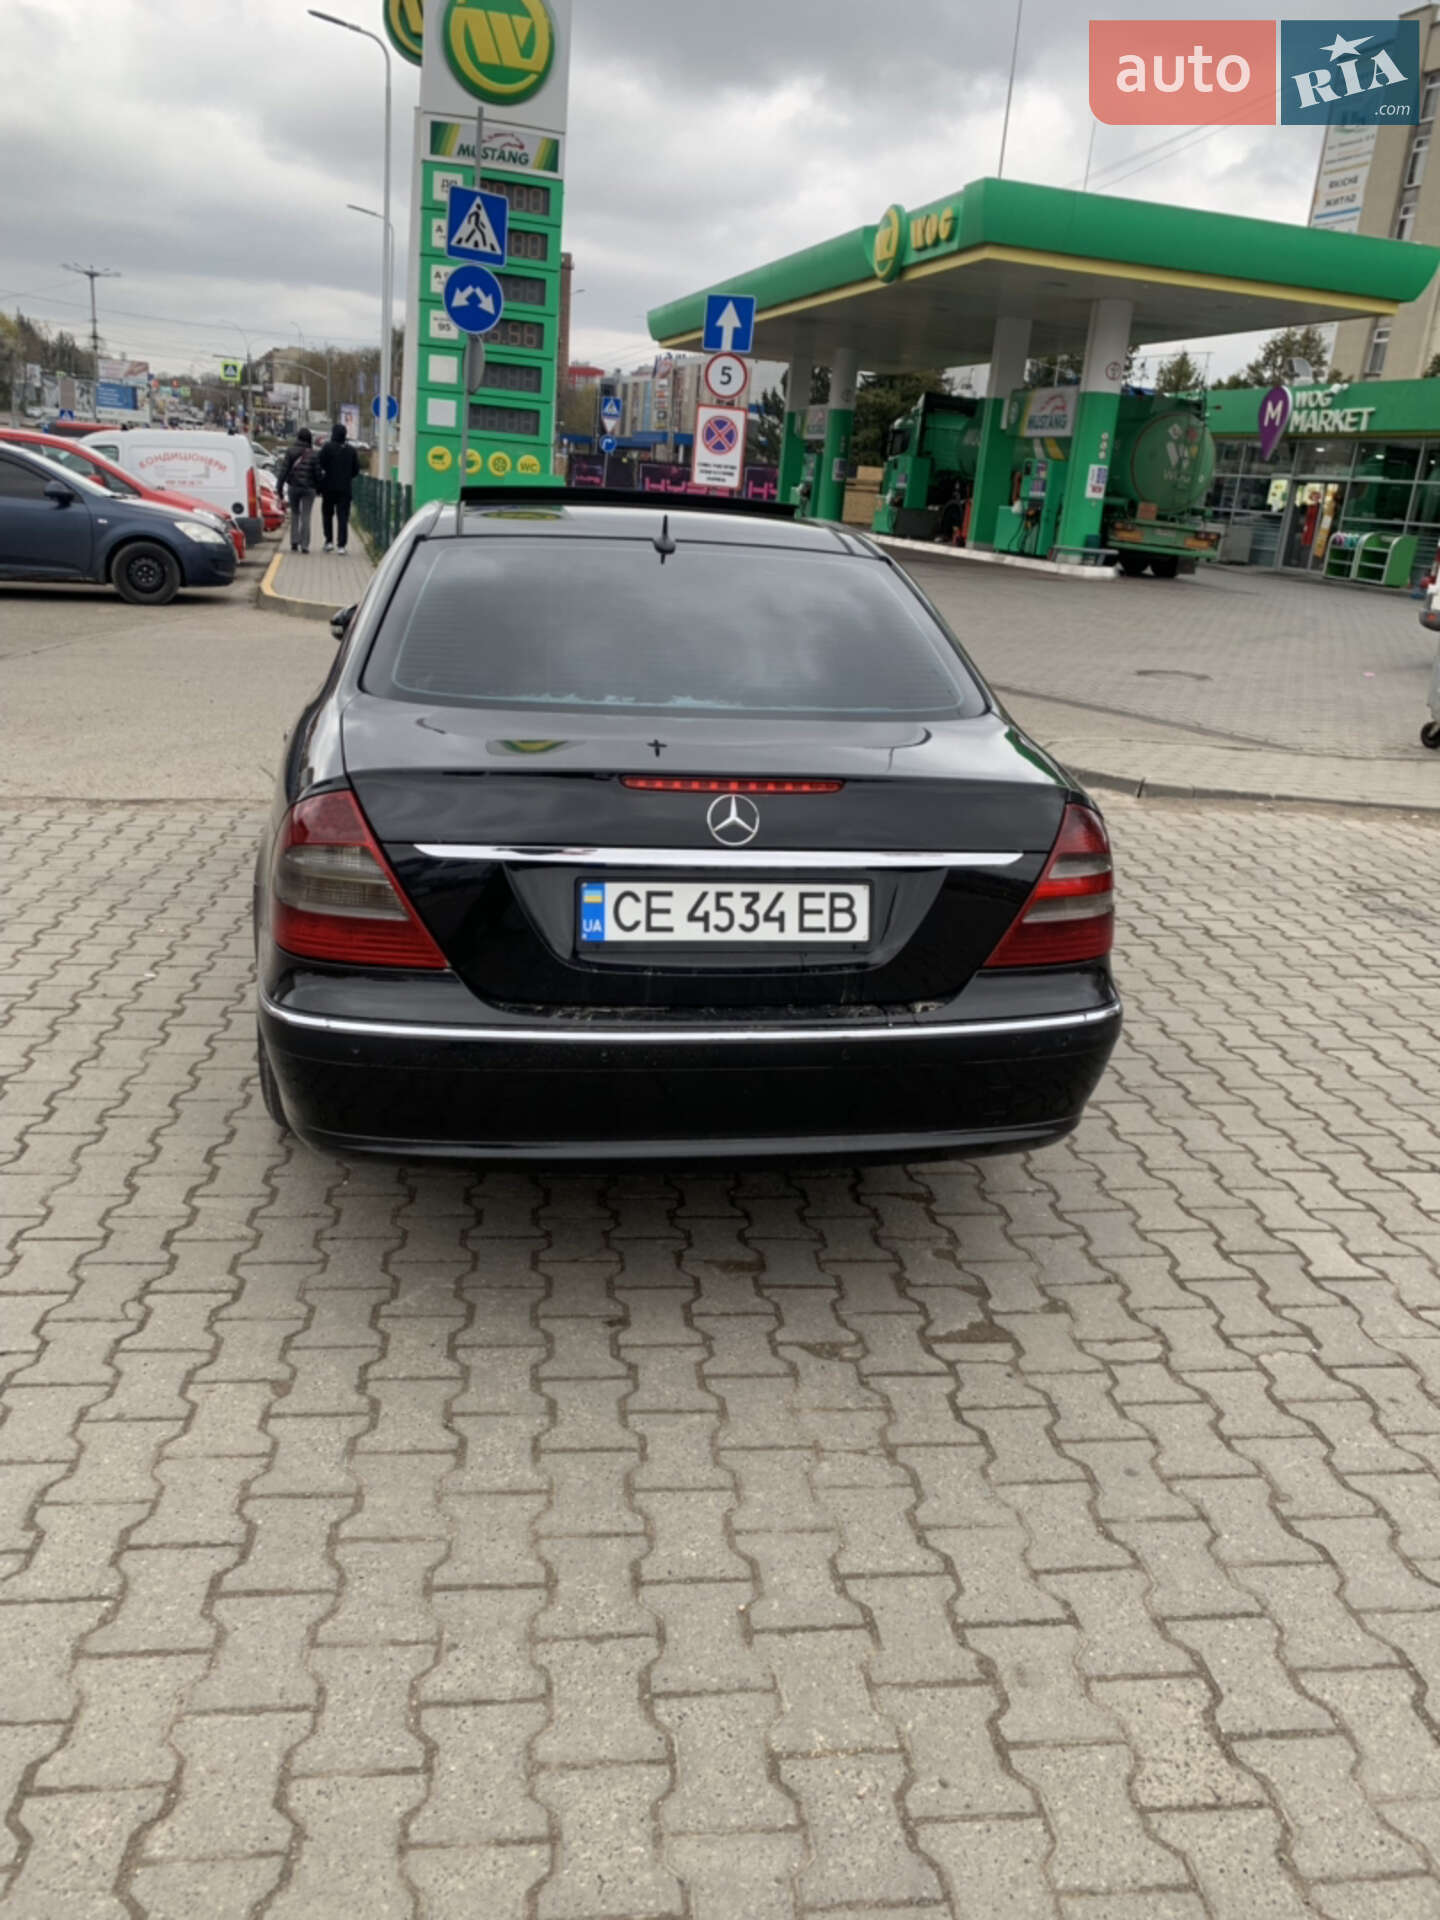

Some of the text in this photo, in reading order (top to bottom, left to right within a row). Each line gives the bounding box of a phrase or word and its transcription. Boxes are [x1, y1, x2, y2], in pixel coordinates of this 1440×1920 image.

[719, 365, 733, 386] 5
[1295, 390, 1334, 409] WOG
[1027, 413, 1068, 431] MUSTANG
[1263, 399, 1284, 427] M
[1288, 407, 1377, 433] MARKET
[613, 889, 858, 934] CE 4534 EB
[583, 919, 603, 933] UA
